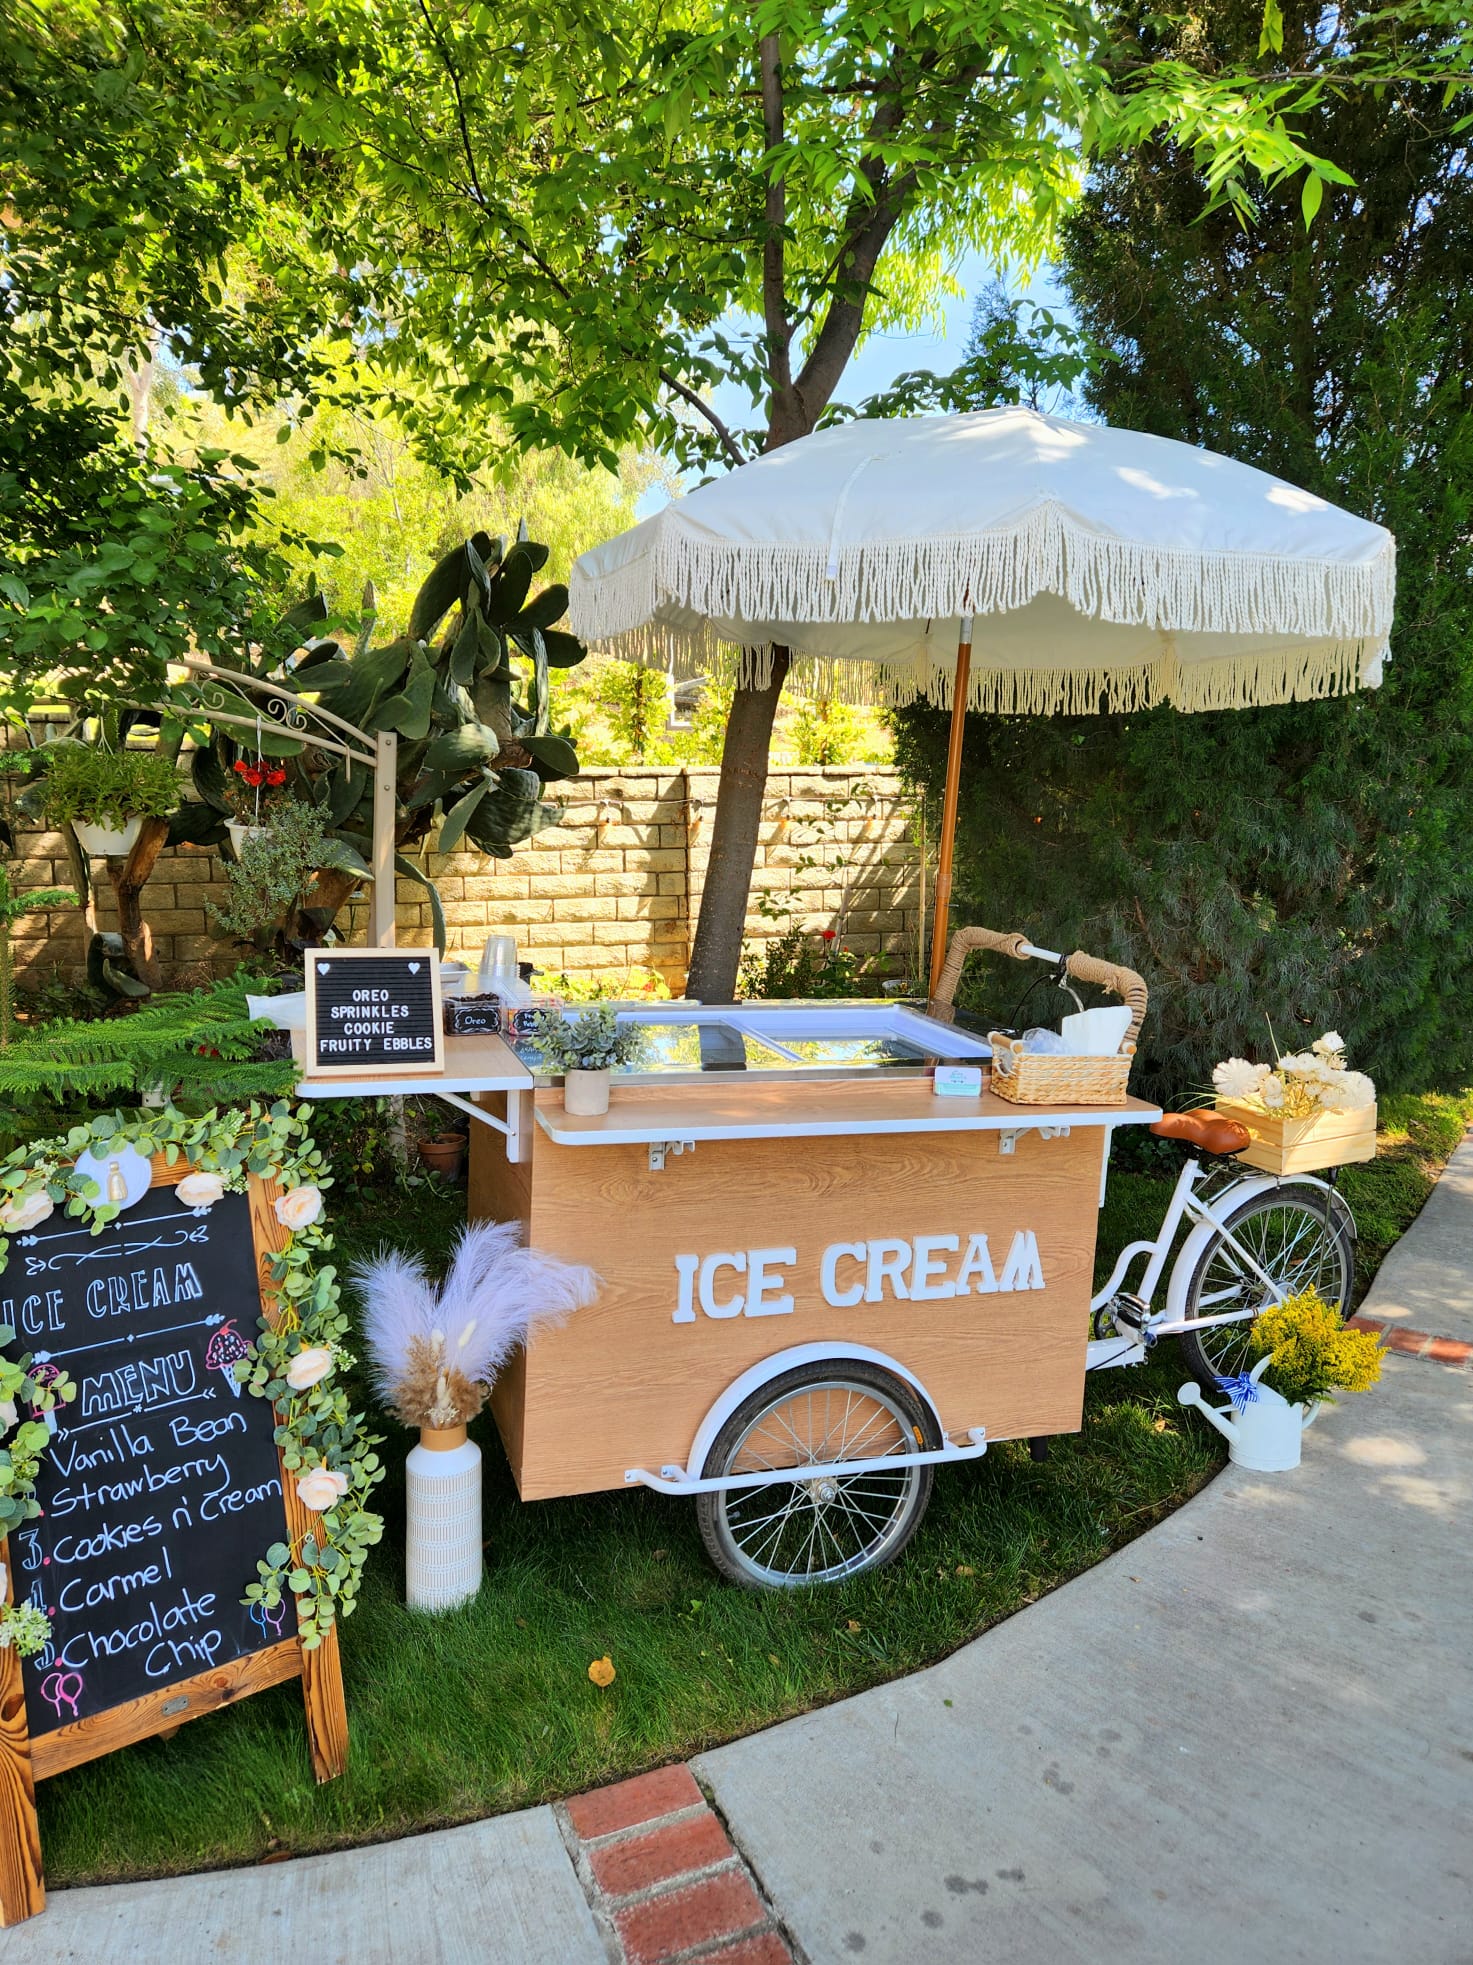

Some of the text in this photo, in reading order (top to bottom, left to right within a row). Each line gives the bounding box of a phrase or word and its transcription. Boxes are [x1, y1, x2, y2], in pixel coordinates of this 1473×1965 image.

[330, 1005, 409, 1019] SPRINKLES
[352, 989, 389, 1002] OREO
[464, 1016, 486, 1025] Oreo
[320, 1037, 433, 1053] FRUITY EBBLES
[343, 1022, 395, 1035] COOKIE
[1, 1262, 203, 1339] ICE CREAM
[671, 1229, 1047, 1324] ICE CREAM
[81, 1349, 196, 1417] MENU
[49, 1411, 248, 1479] Vanilla Bean
[50, 1453, 231, 1518] Strawberry
[52, 1514, 164, 1565] Cookies
[59, 1545, 173, 1613] Carmel
[60, 1587, 217, 1669] Chocolate
[144, 1629, 223, 1678] Chip
